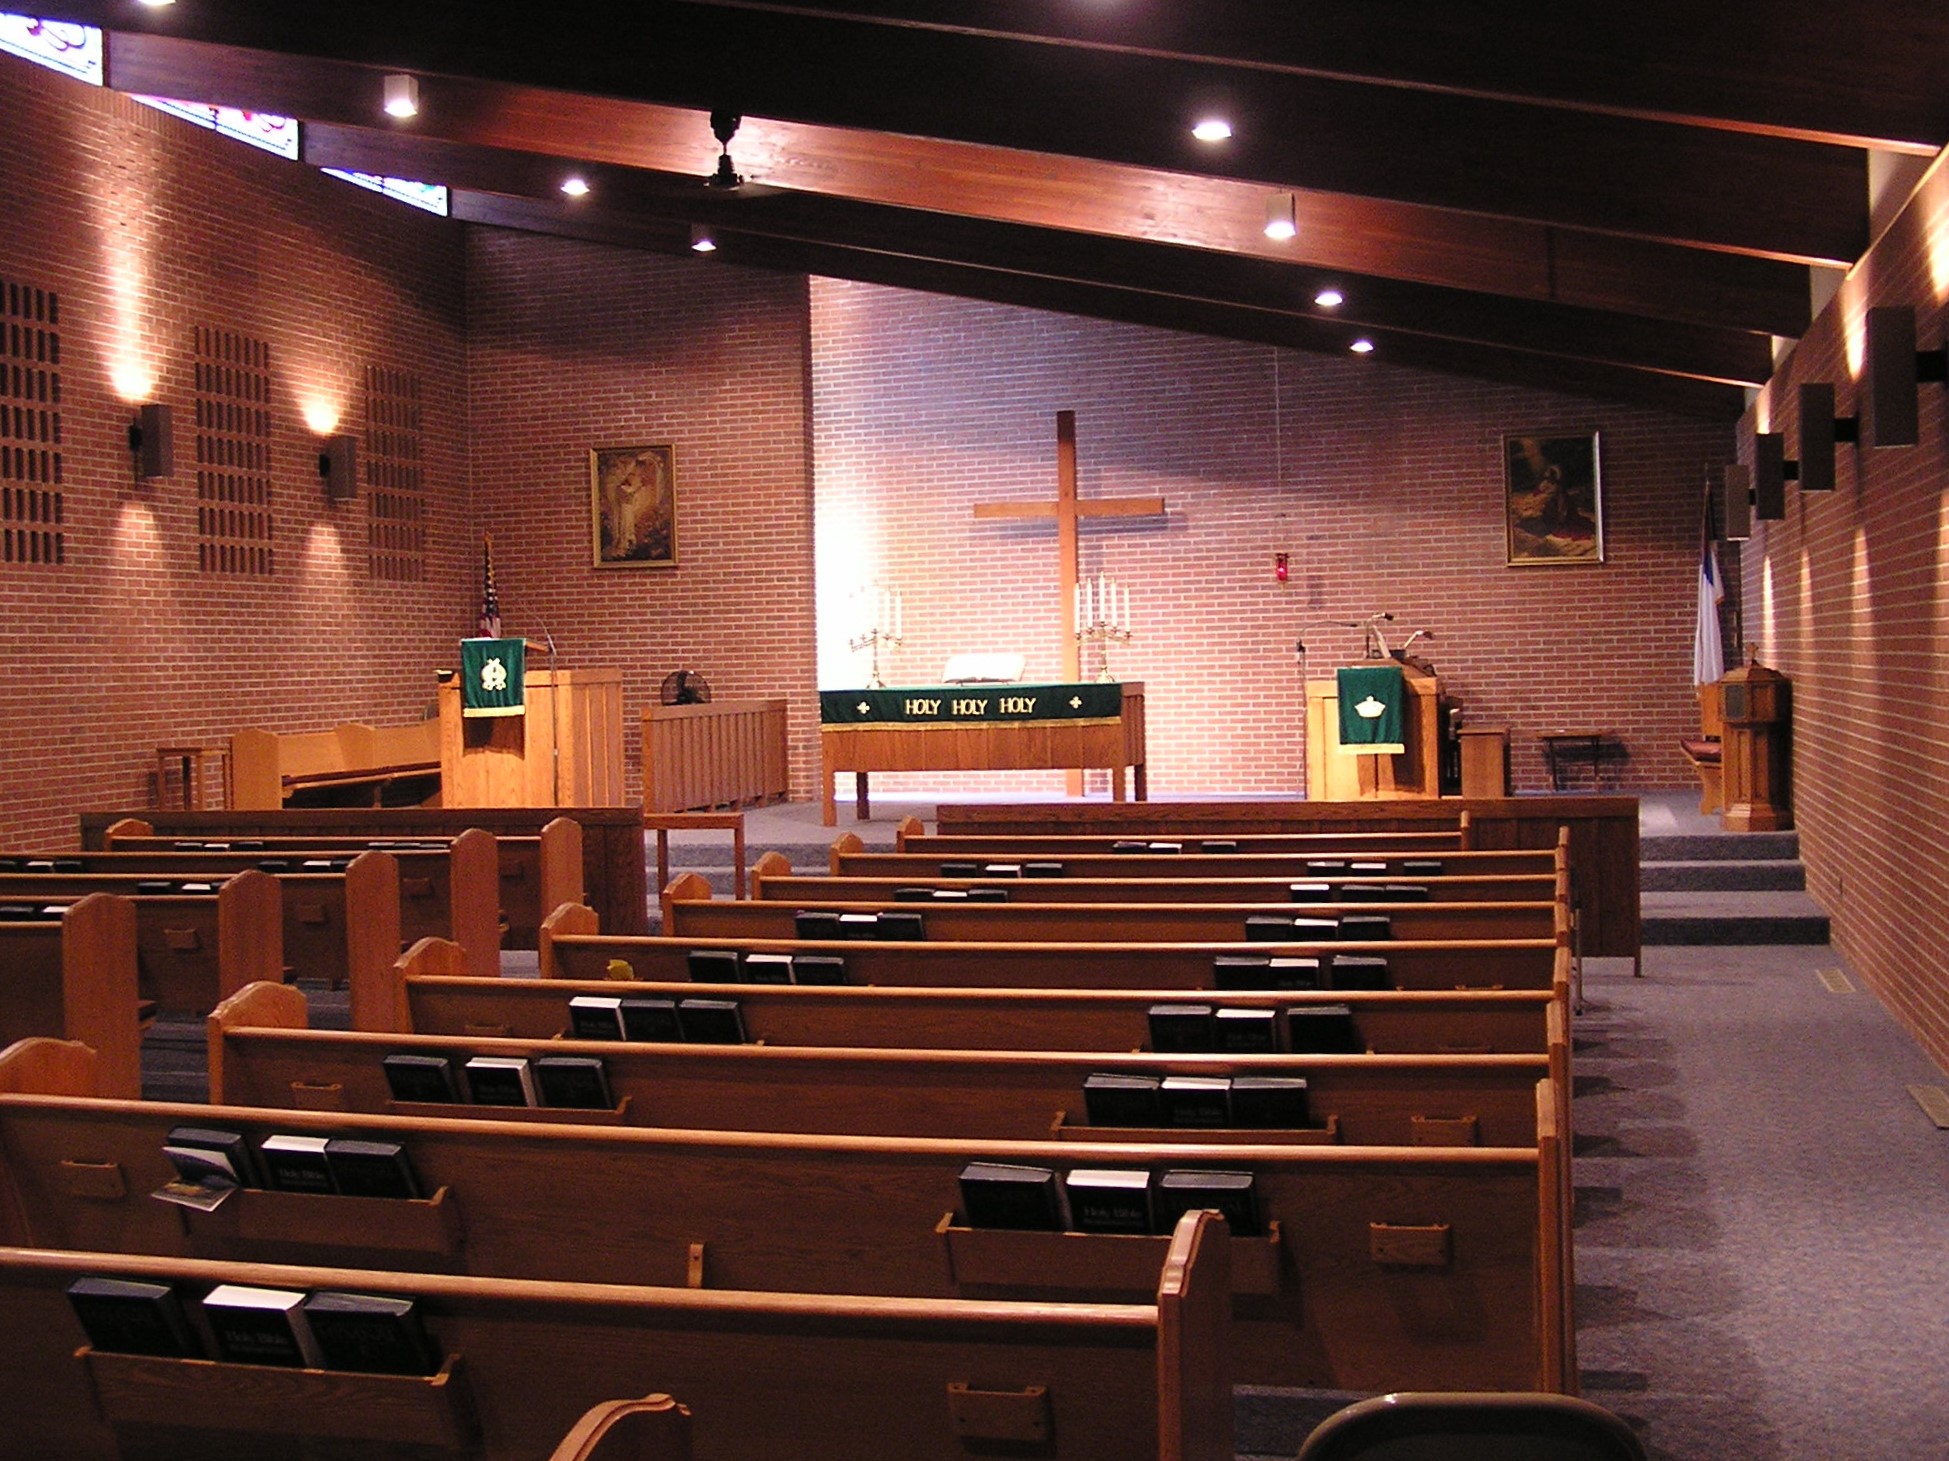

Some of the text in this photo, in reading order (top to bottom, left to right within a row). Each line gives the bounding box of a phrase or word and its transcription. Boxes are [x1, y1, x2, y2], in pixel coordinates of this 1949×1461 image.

[904, 696, 1037, 716] HOLY HOLY HOLY
